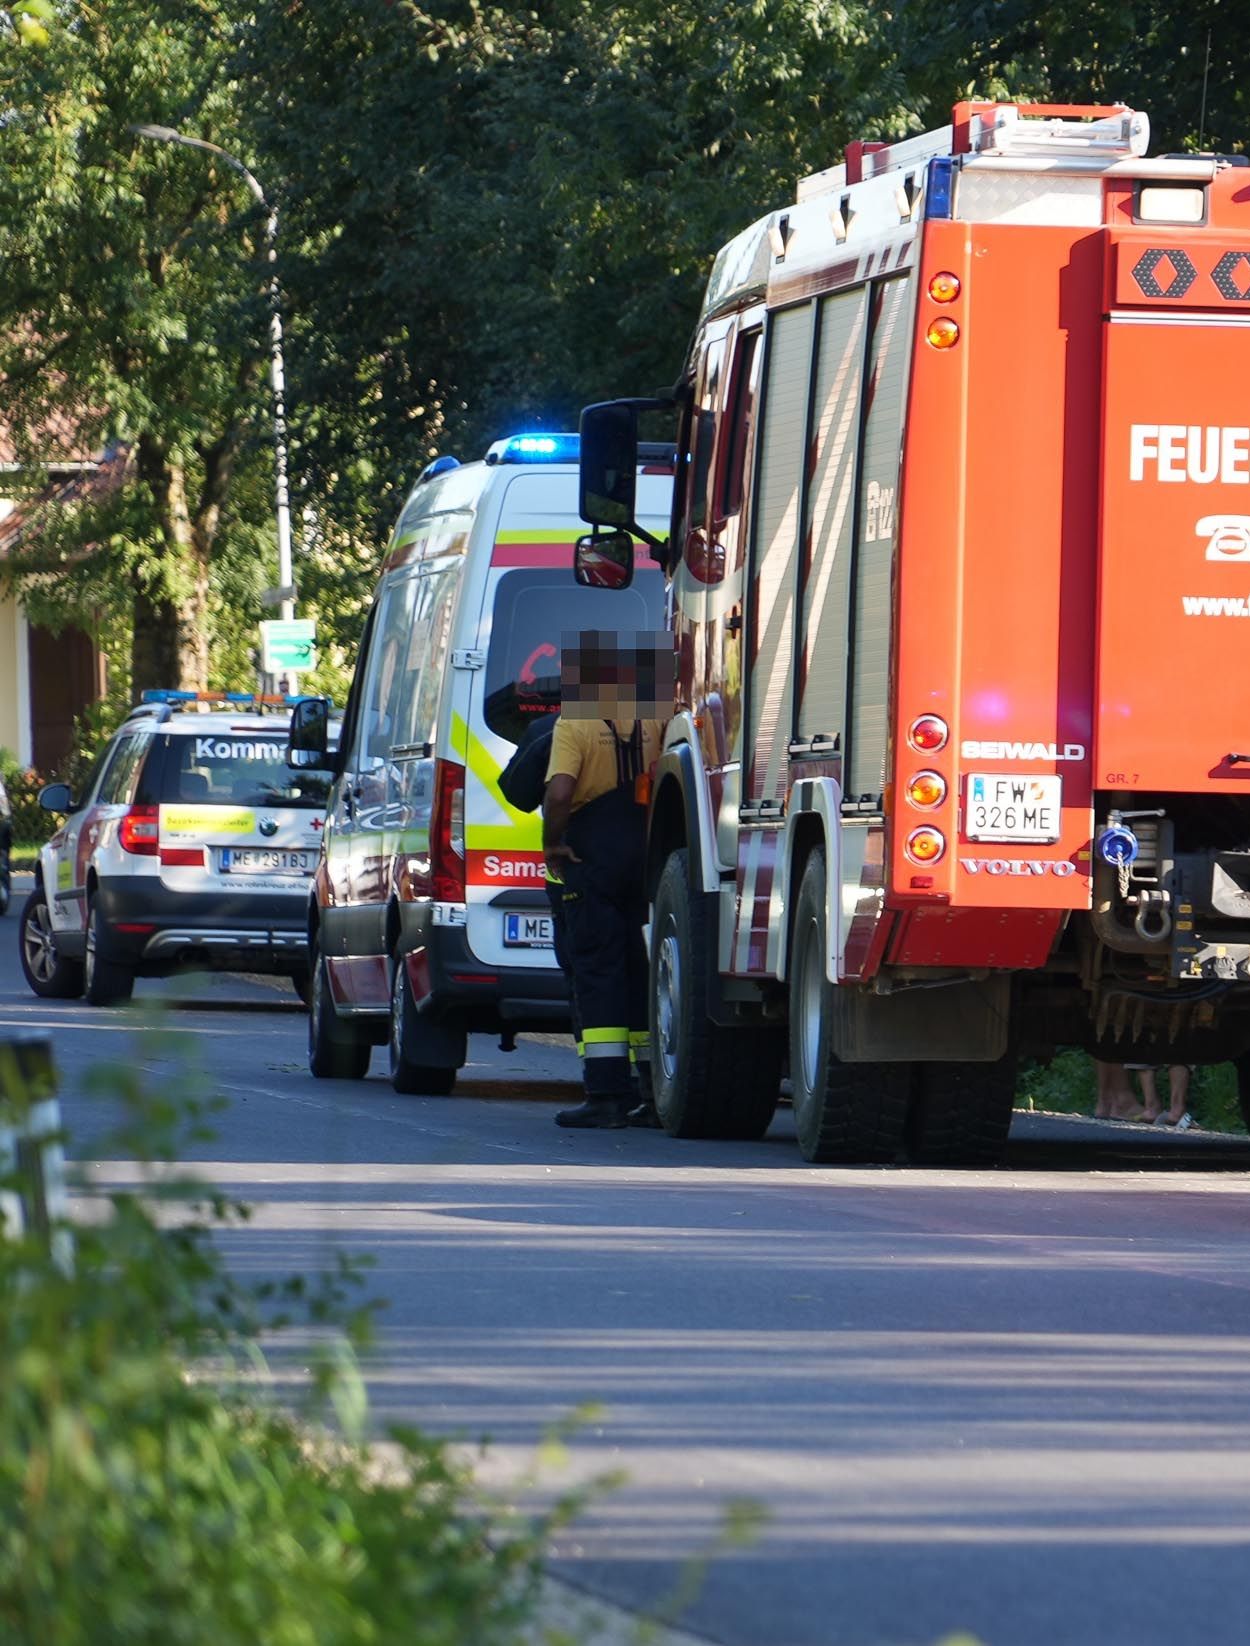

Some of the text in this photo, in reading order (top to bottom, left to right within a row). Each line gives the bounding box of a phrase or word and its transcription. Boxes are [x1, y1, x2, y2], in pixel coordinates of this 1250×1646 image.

[960, 740, 1086, 761] SEIWALD
[1105, 773, 1140, 784] GR. 7
[995, 781, 1027, 803] FW
[975, 805, 1052, 830] 326 ME
[482, 855, 547, 878] Sama
[959, 857, 1077, 877] VOLVO
[524, 918, 550, 938] ME
